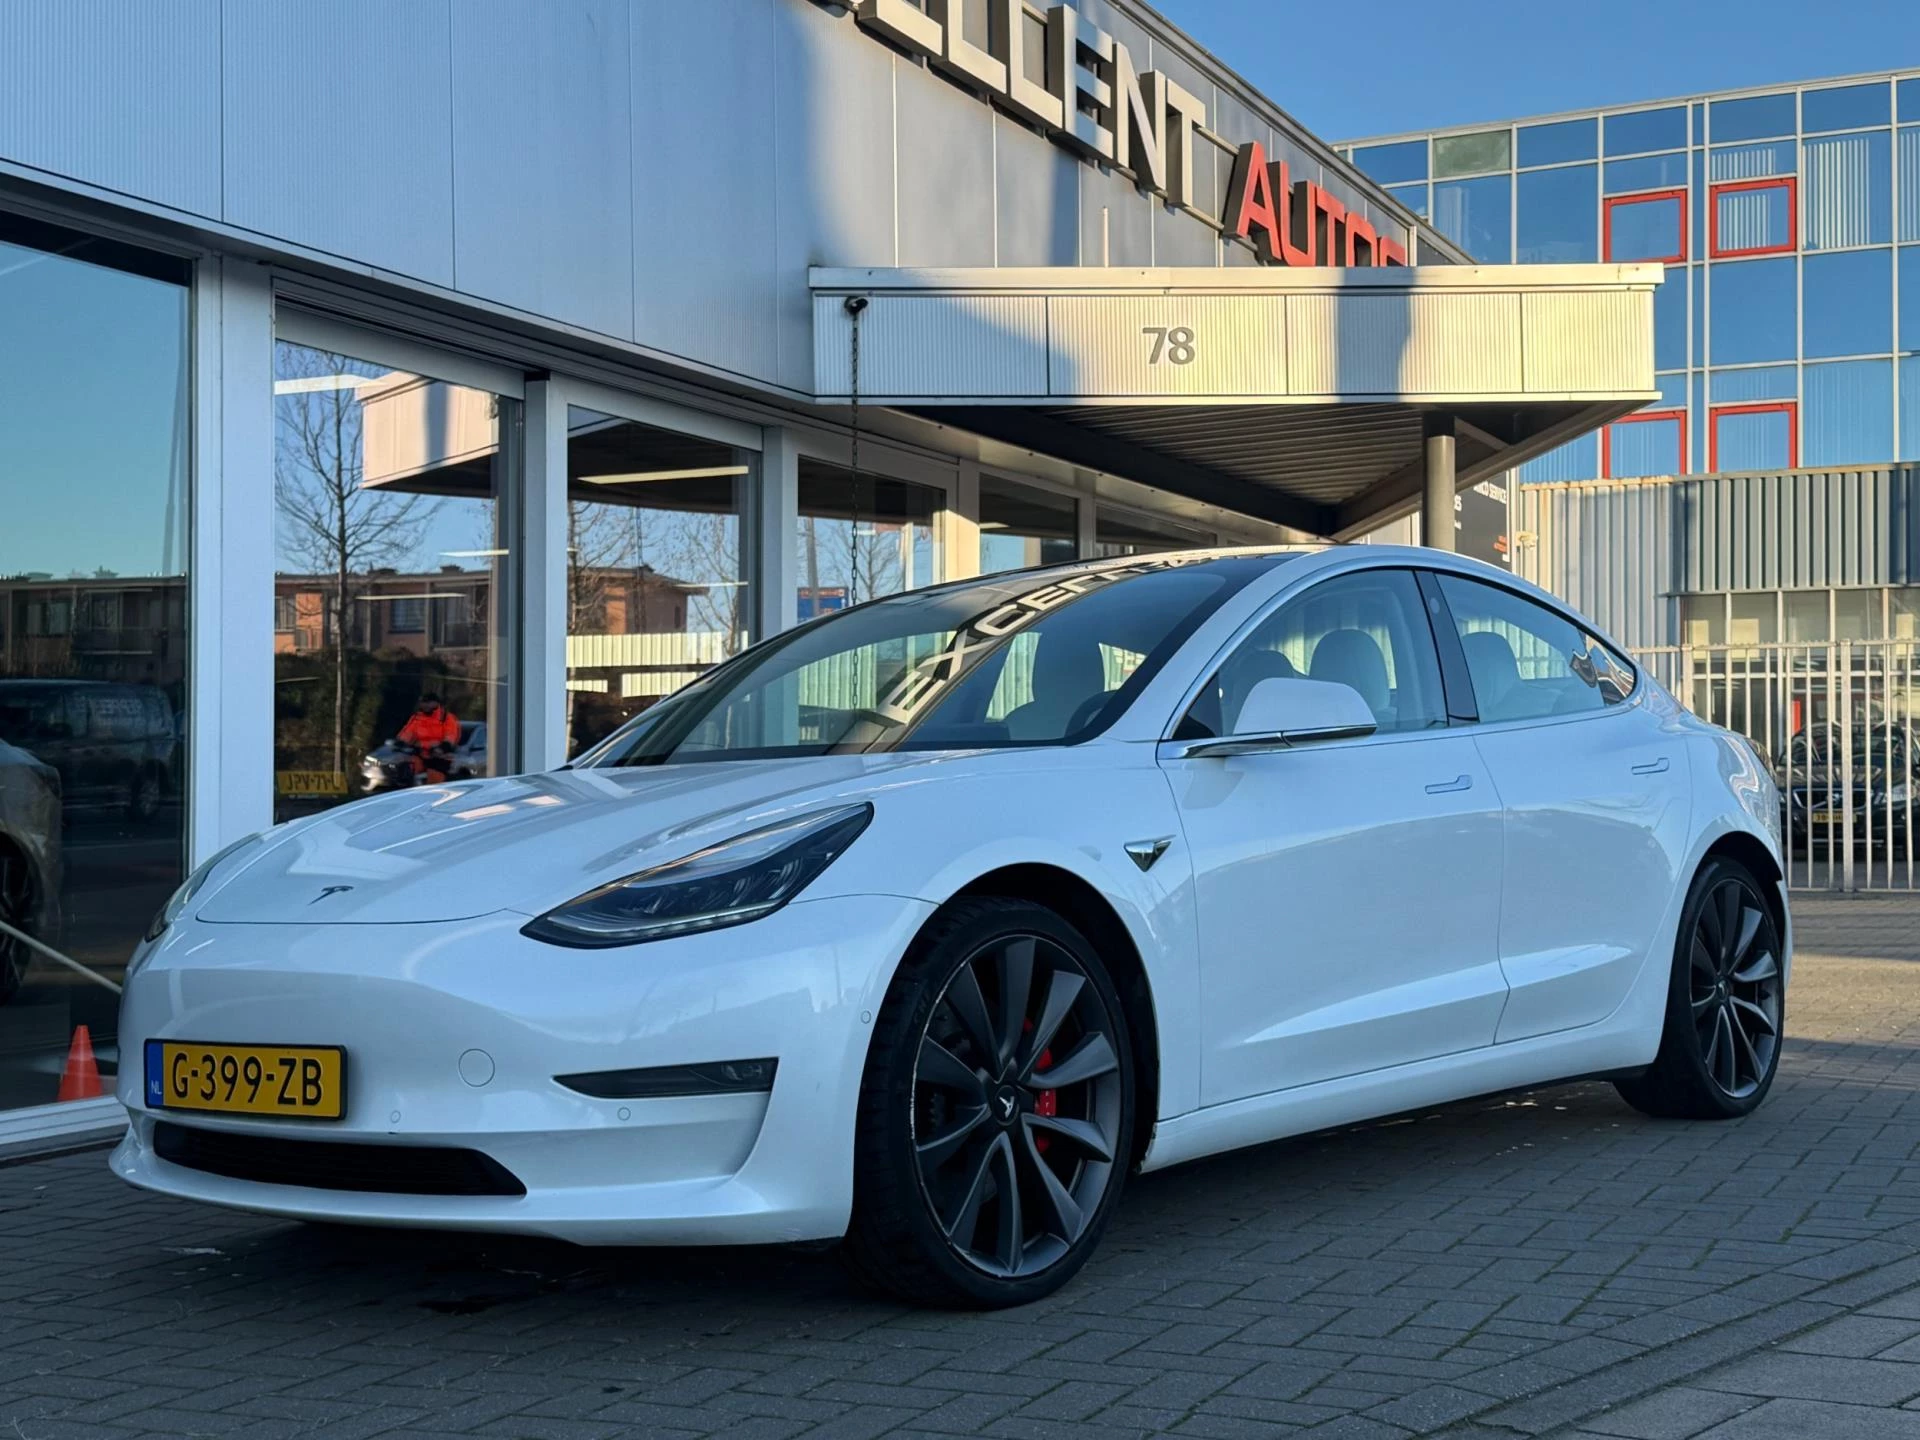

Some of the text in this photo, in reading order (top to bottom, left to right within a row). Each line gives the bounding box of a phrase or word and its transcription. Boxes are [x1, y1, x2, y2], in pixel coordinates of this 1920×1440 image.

[1142, 326, 1196, 365] 78
[150, 1079, 164, 1096] NL
[171, 1051, 323, 1107] G-399-ZB
